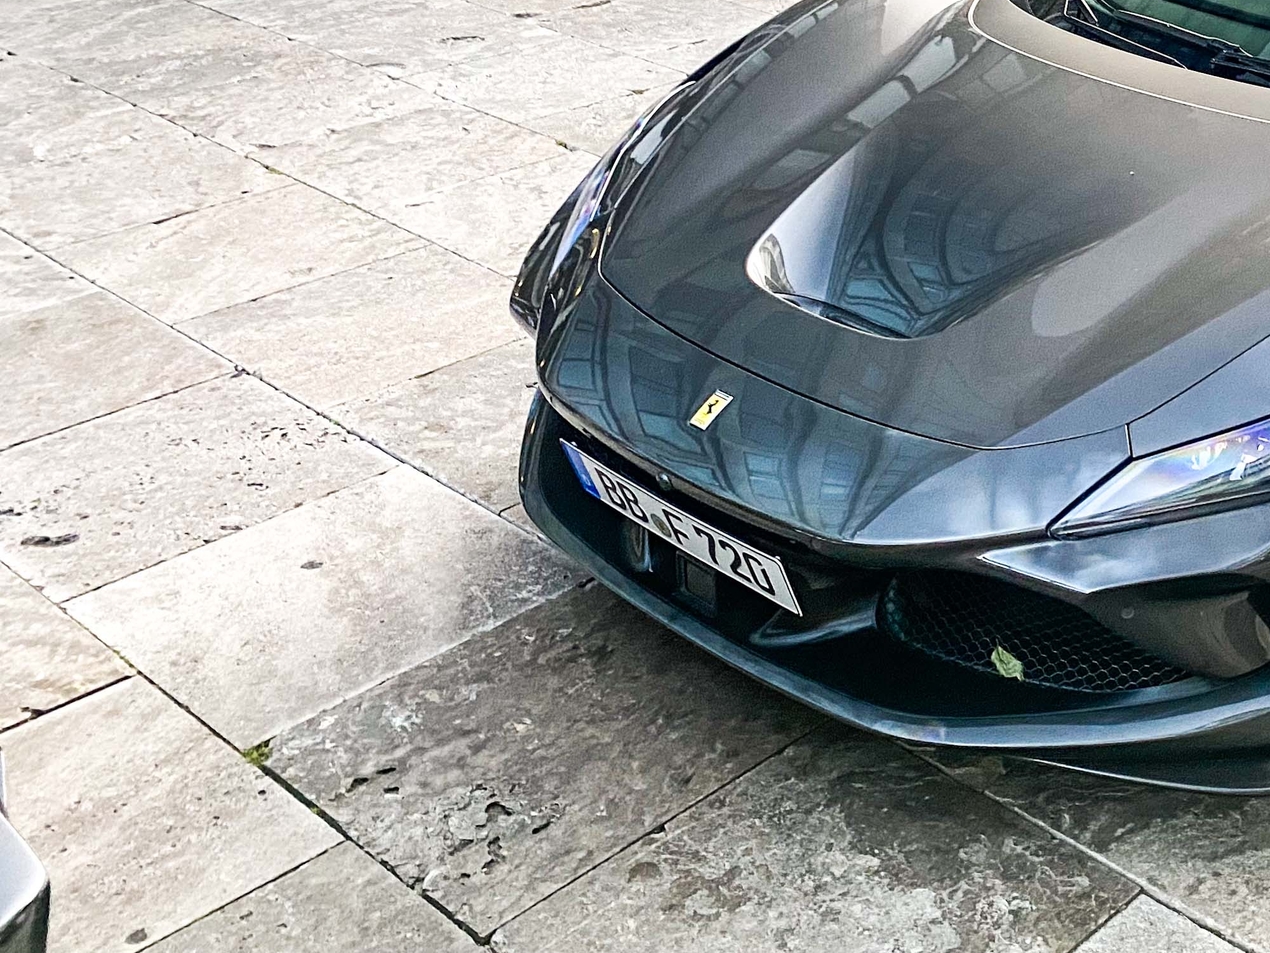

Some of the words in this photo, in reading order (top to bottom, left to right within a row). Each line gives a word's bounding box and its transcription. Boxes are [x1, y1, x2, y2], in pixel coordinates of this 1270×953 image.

[594, 467, 650, 523] BB
[662, 508, 689, 545] F
[692, 524, 776, 596] 720
